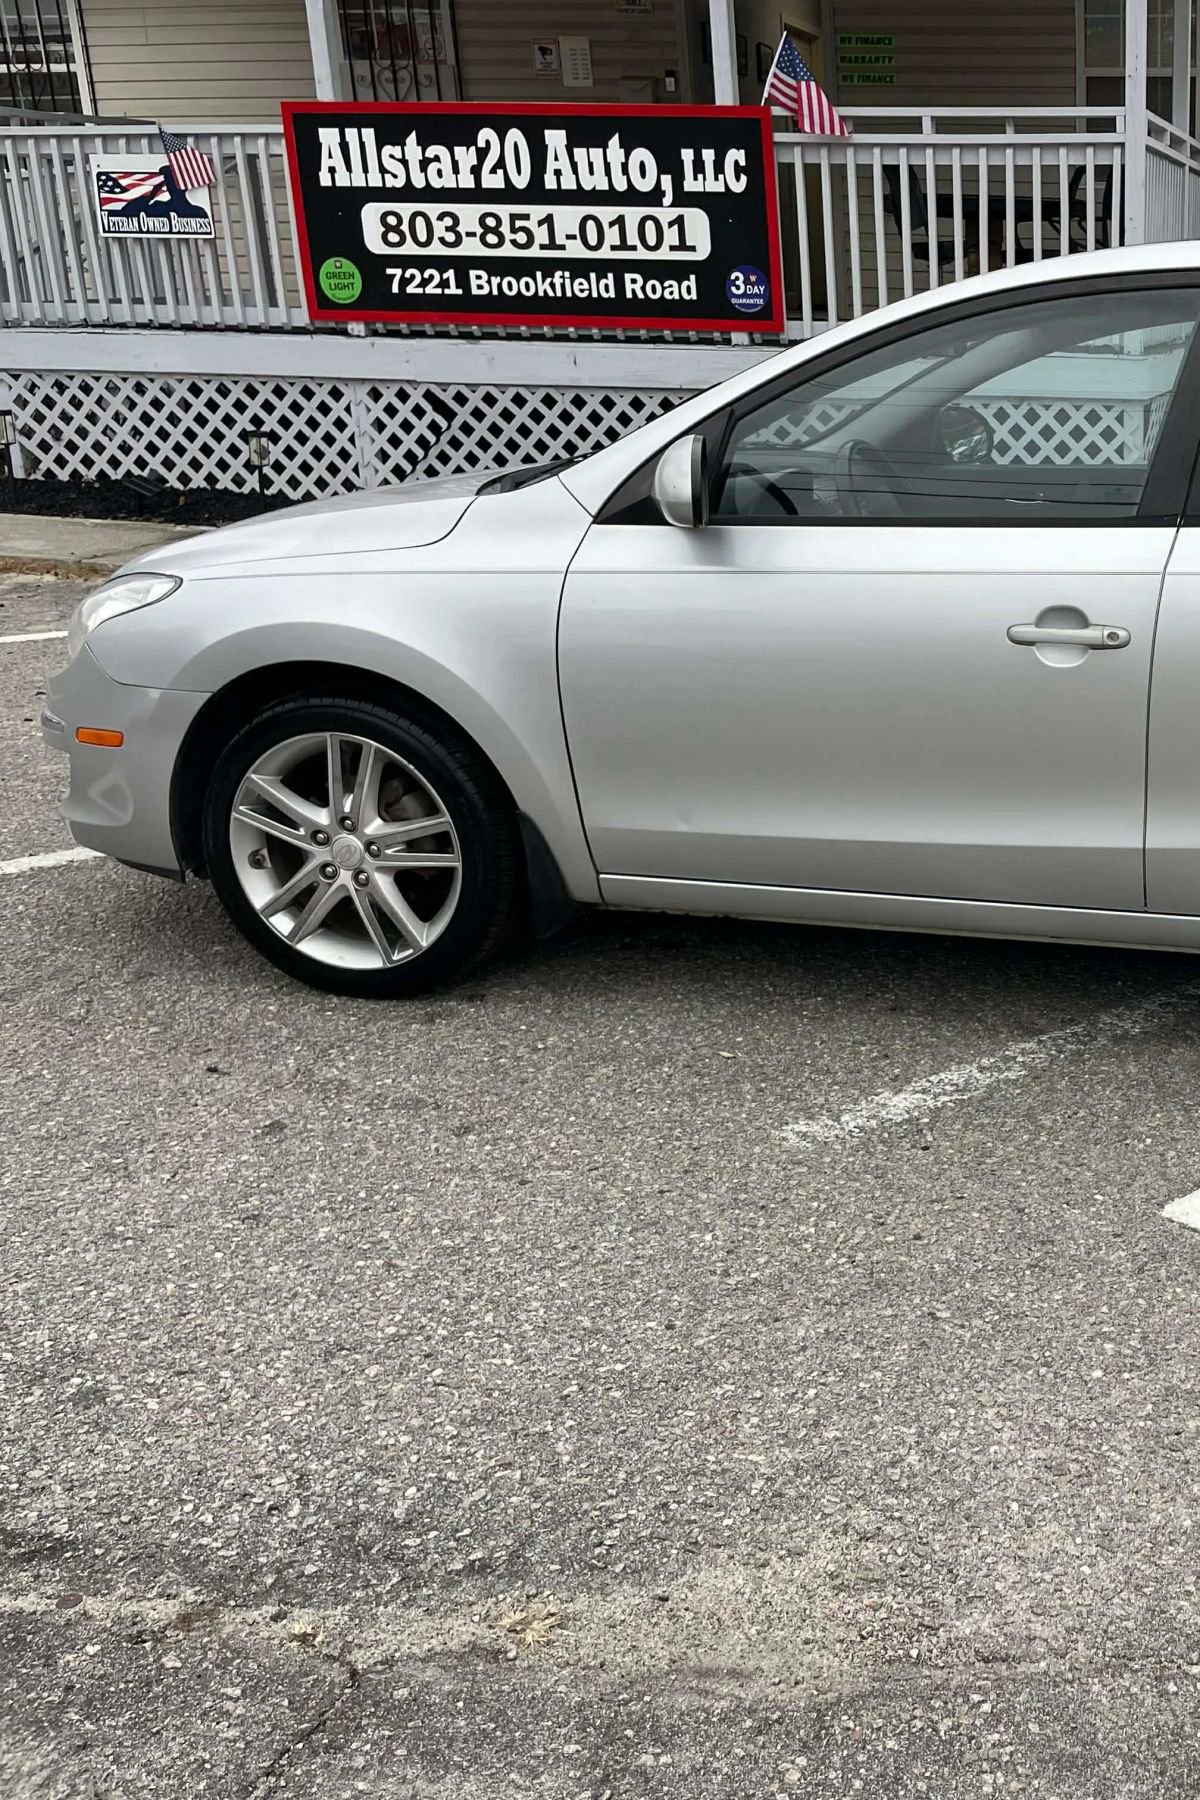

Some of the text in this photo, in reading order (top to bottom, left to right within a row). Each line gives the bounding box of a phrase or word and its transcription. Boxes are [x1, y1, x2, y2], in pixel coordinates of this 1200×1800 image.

[317, 127, 748, 207] Allstar20 Auto, LLC
[100, 211, 211, 233] VETERAN OWNED BUSINESS
[379, 210, 698, 253] 803-851-0101
[325, 271, 355, 280] GREEN
[328, 282, 356, 291] LIGHT
[385, 268, 698, 301] 7221 Brookfield Road
[730, 271, 766, 295] 3 DAY
